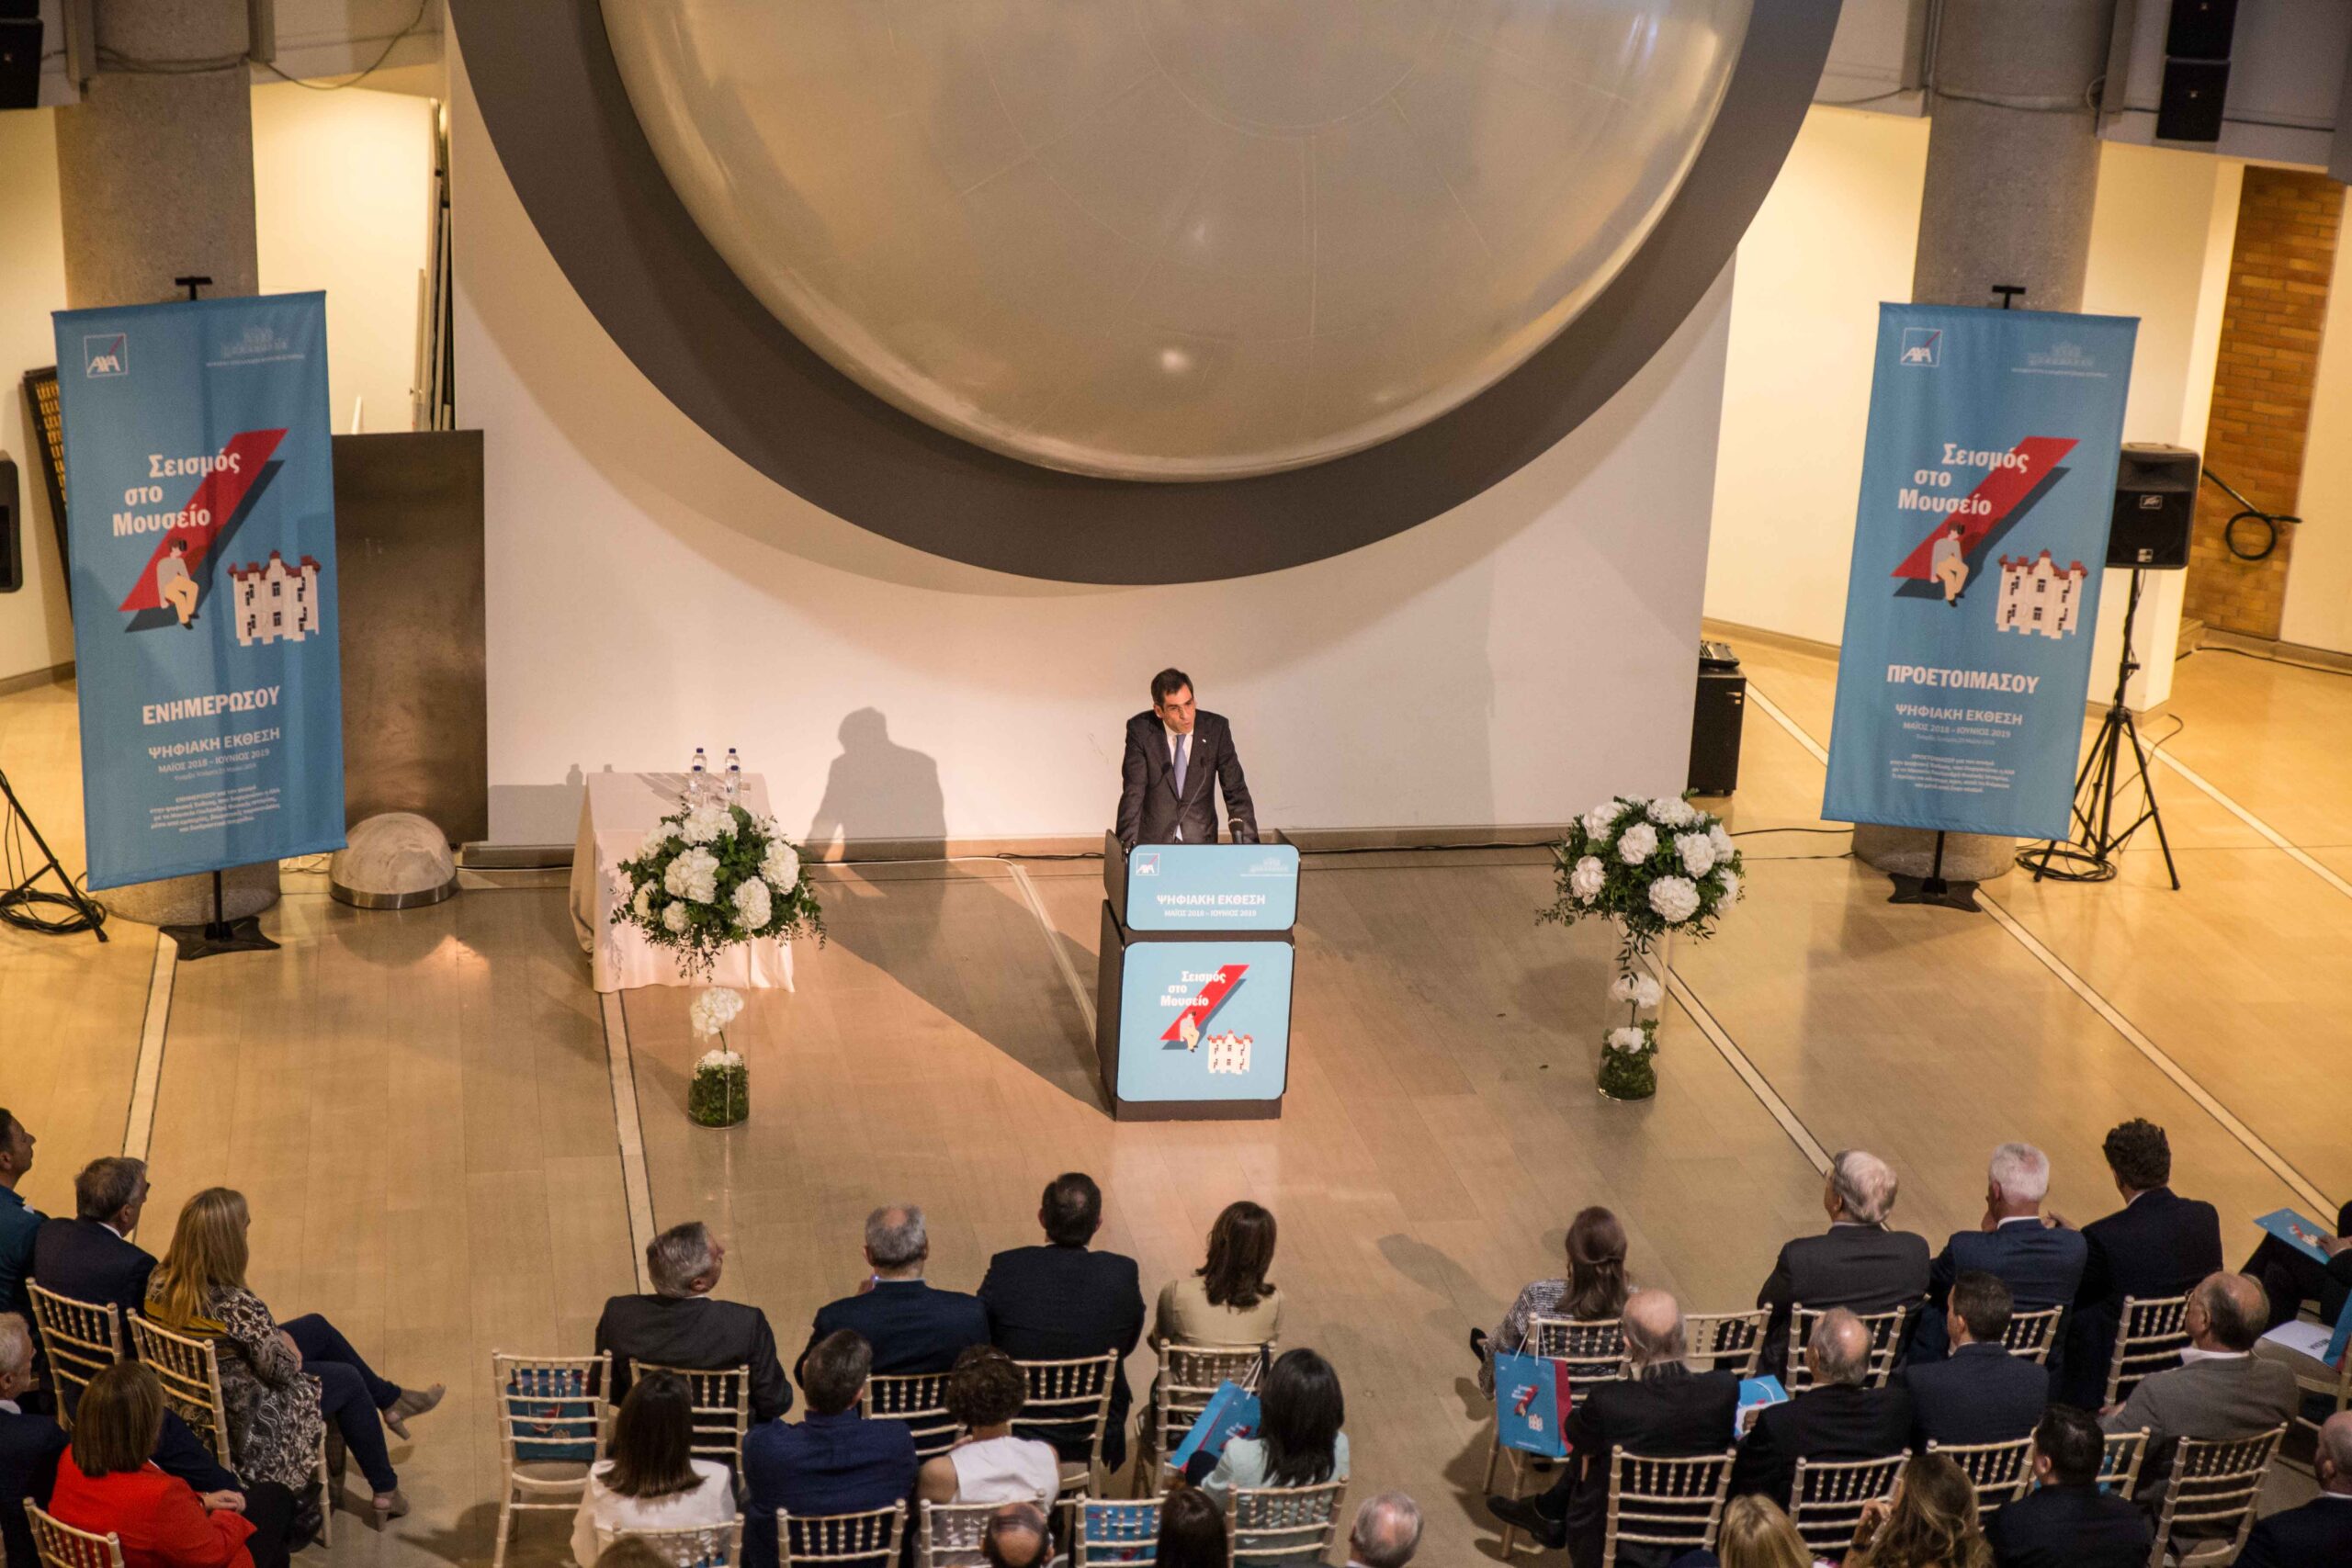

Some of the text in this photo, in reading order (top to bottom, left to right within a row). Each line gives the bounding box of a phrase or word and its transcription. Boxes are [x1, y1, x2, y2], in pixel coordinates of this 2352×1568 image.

[87, 355, 120, 374] AXA
[1901, 346, 1932, 363] AXA
[148, 448, 241, 479] Σεισμός
[1941, 443, 2030, 473] Σεισμός
[1914, 468, 1951, 486] στο
[125, 485, 163, 506] στο
[1897, 488, 1992, 515] Μουσείο
[112, 504, 211, 537] Μουσείο
[1886, 664, 2040, 694] ΠΡΟΕΤΟΙΜΑΣΟΥ
[142, 685, 280, 726] ΕΝΗΜΕΡΩΣΟΥ
[1895, 704, 2023, 725] ΨΗΦΙΑΚΗ ΕΚΘΕΣΗ
[148, 728, 280, 760] ΨΗΦΙΑΚΗ ΕΚΘΕΣΗ
[1157, 894, 1265, 906] ΨΗΦΙΑΚΗ ΕΚΘΕΣΗ
[1182, 970, 1227, 984] Σεισμός
[1168, 984, 1188, 995] στο
[1160, 994, 1209, 1008] Μουσείο
